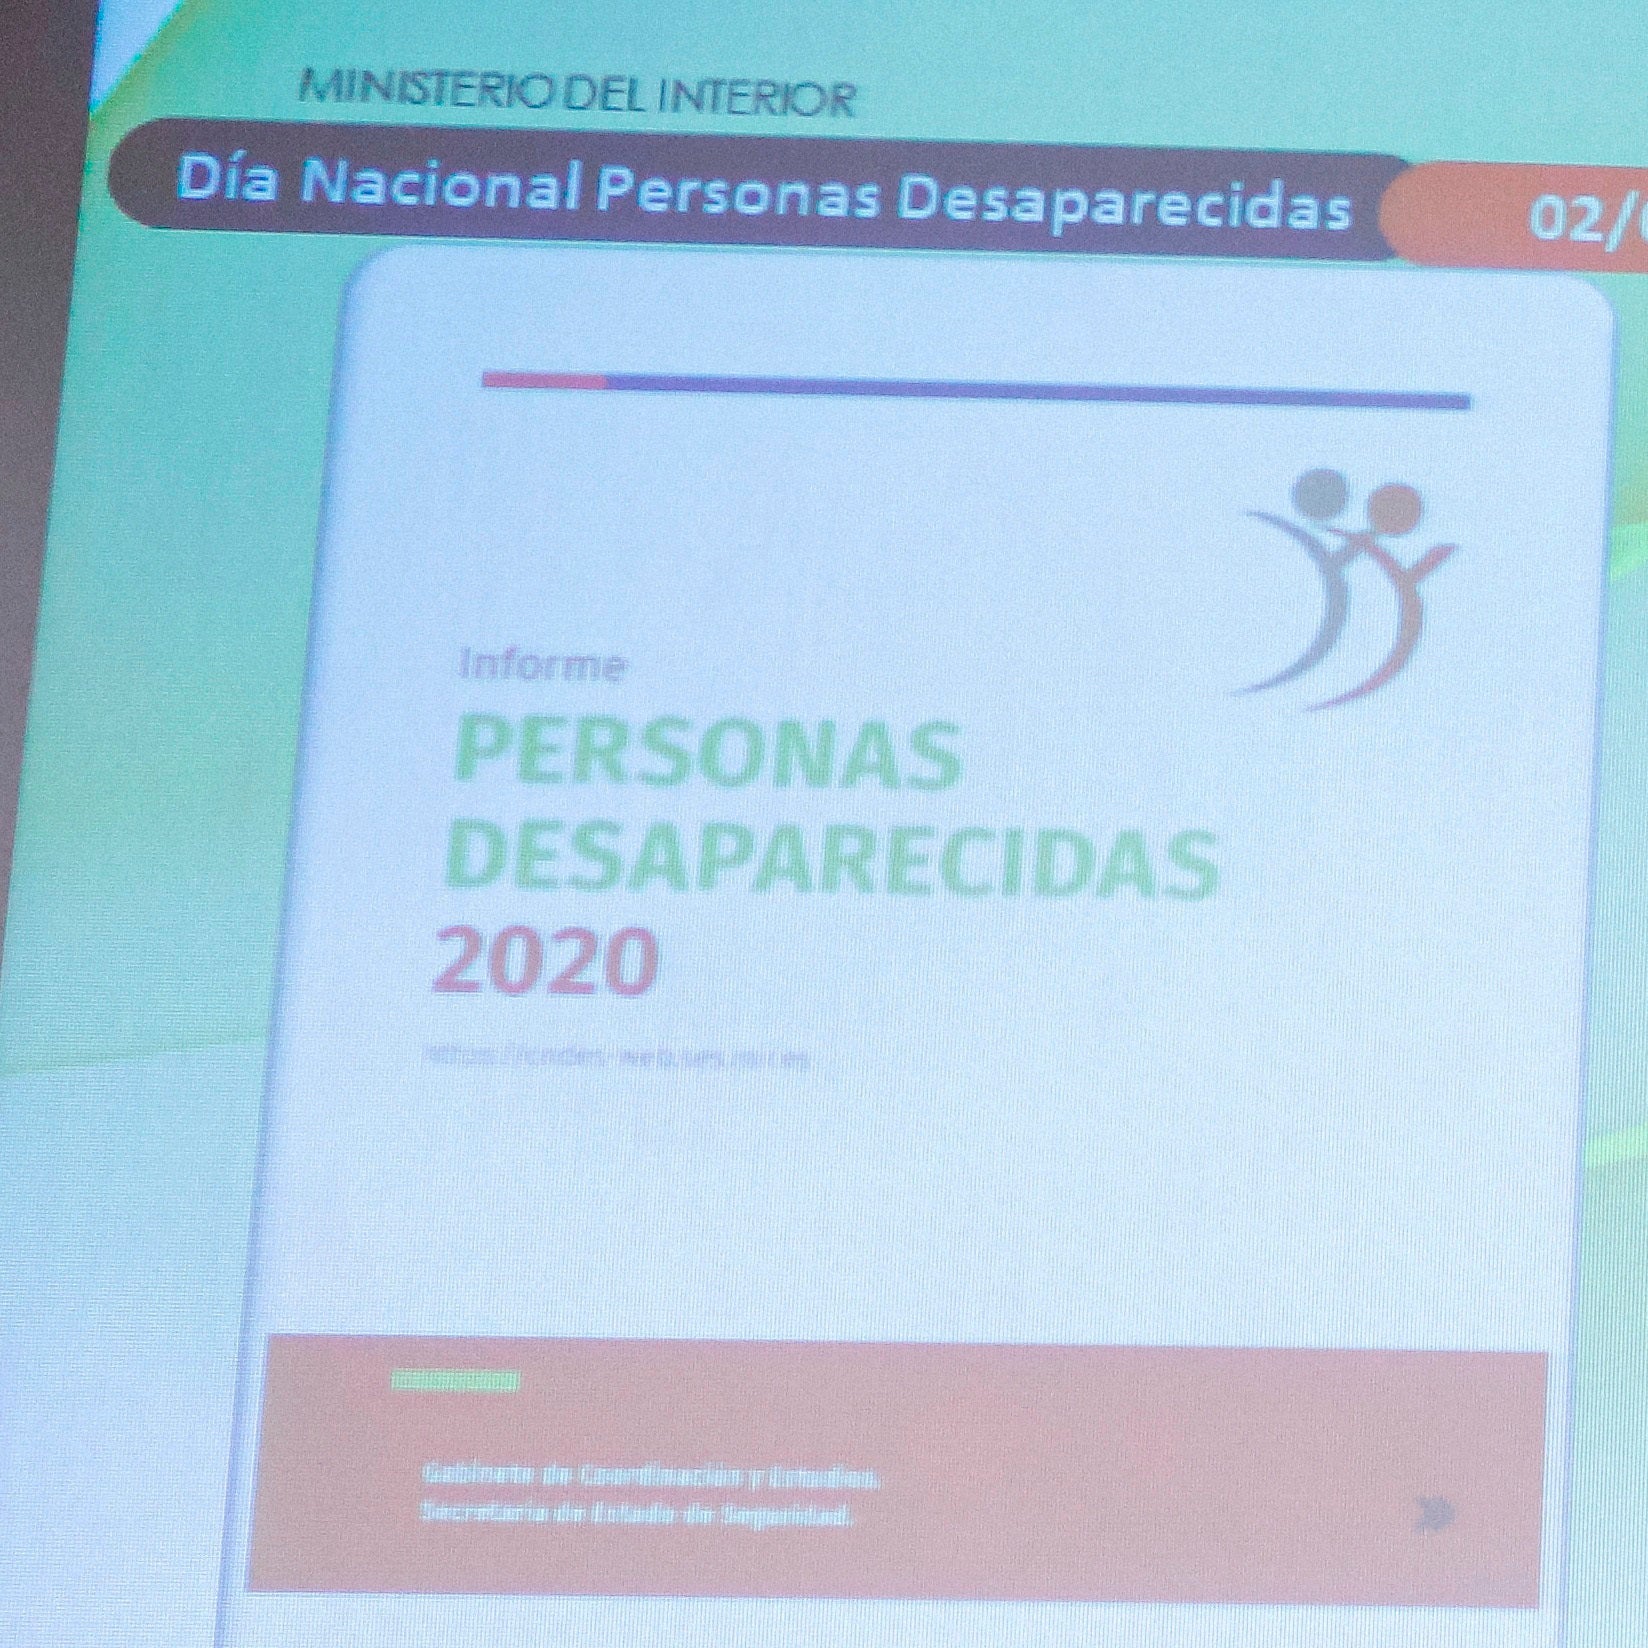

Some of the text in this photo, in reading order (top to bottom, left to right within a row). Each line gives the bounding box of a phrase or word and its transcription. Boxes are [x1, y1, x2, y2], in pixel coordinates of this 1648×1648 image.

[298, 66, 858, 119] MINISTERIO DEL INTERIOR
[176, 148, 1353, 238] Día Nacional Personas Desaparecidas
[457, 646, 630, 684] Informe
[453, 710, 963, 793] PERSONAS
[443, 816, 1221, 903] DESAPARECIDAS
[431, 922, 661, 1000] 2020
